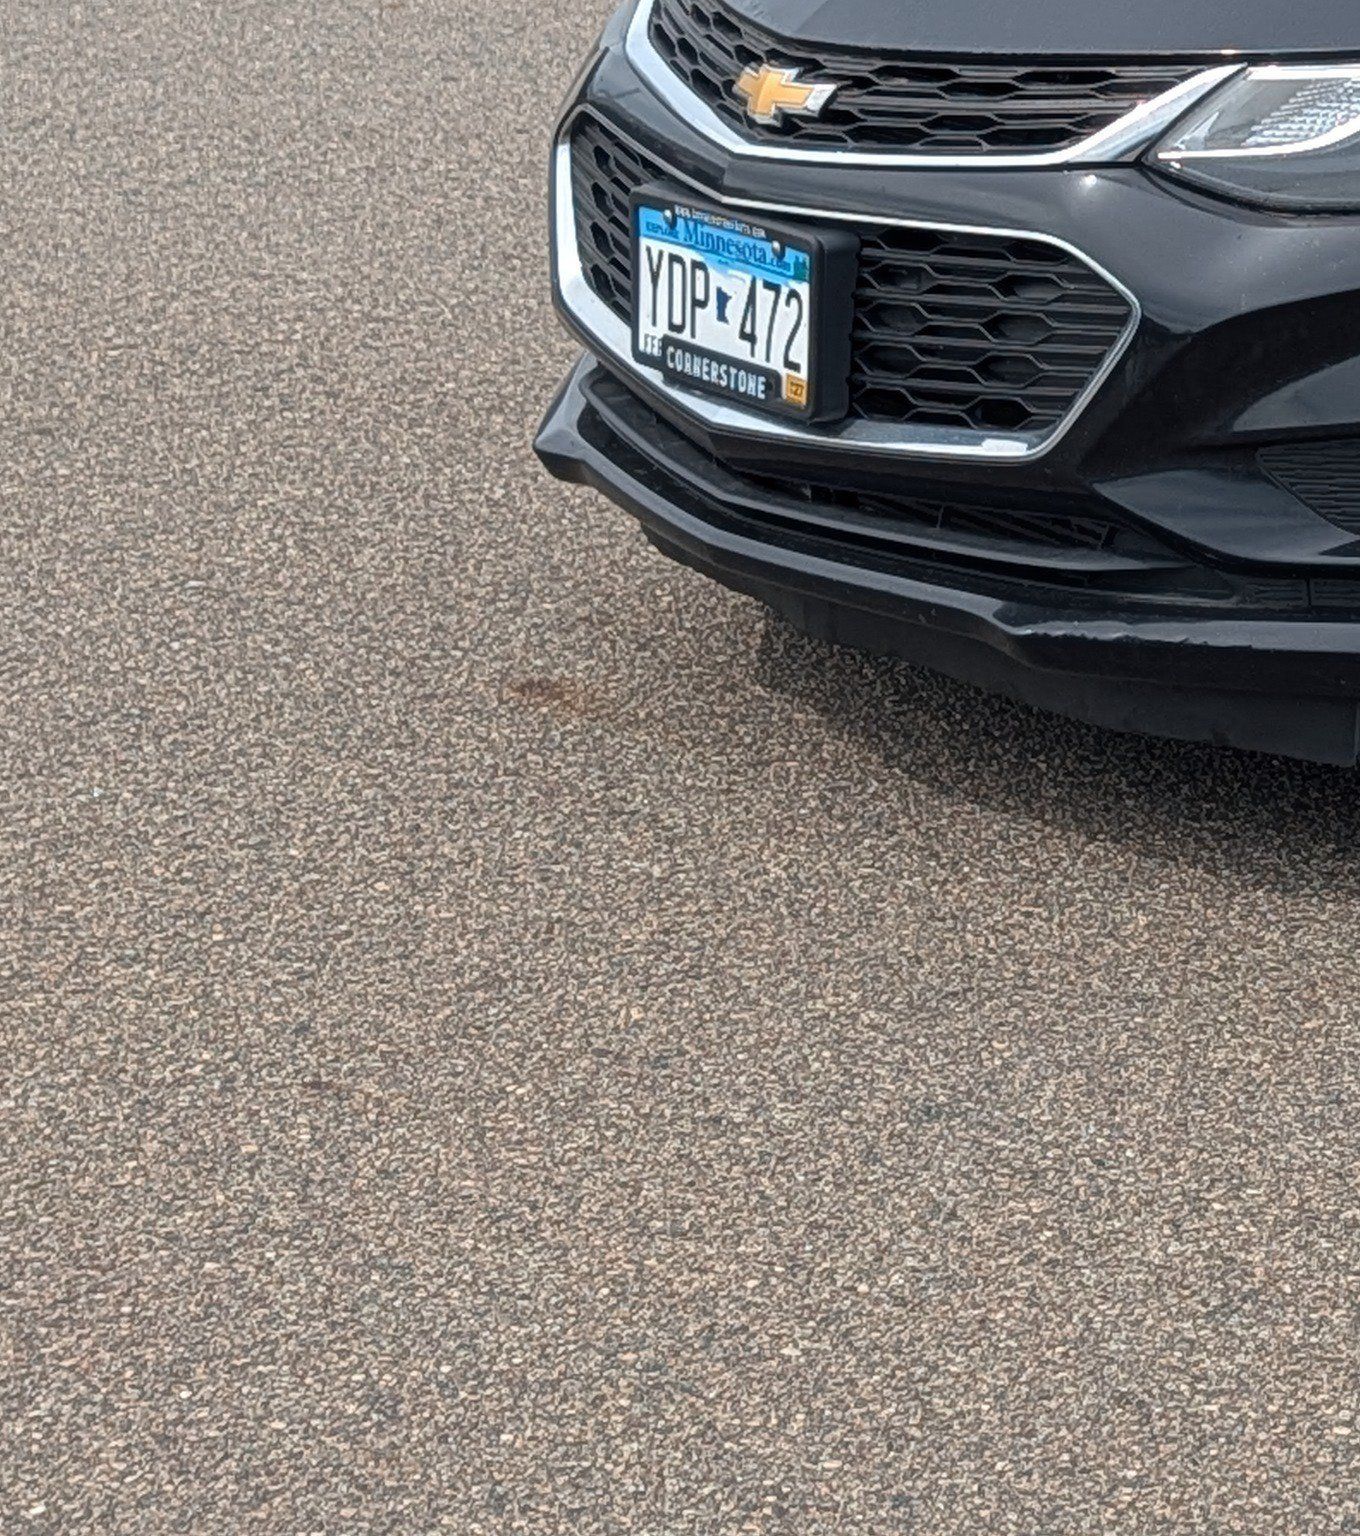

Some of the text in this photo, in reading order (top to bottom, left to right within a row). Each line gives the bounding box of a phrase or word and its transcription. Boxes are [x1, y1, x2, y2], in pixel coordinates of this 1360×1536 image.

[683, 219, 767, 264] Minnesota
[645, 245, 804, 374] YDP 472
[666, 345, 767, 400] CORNERSTONE
